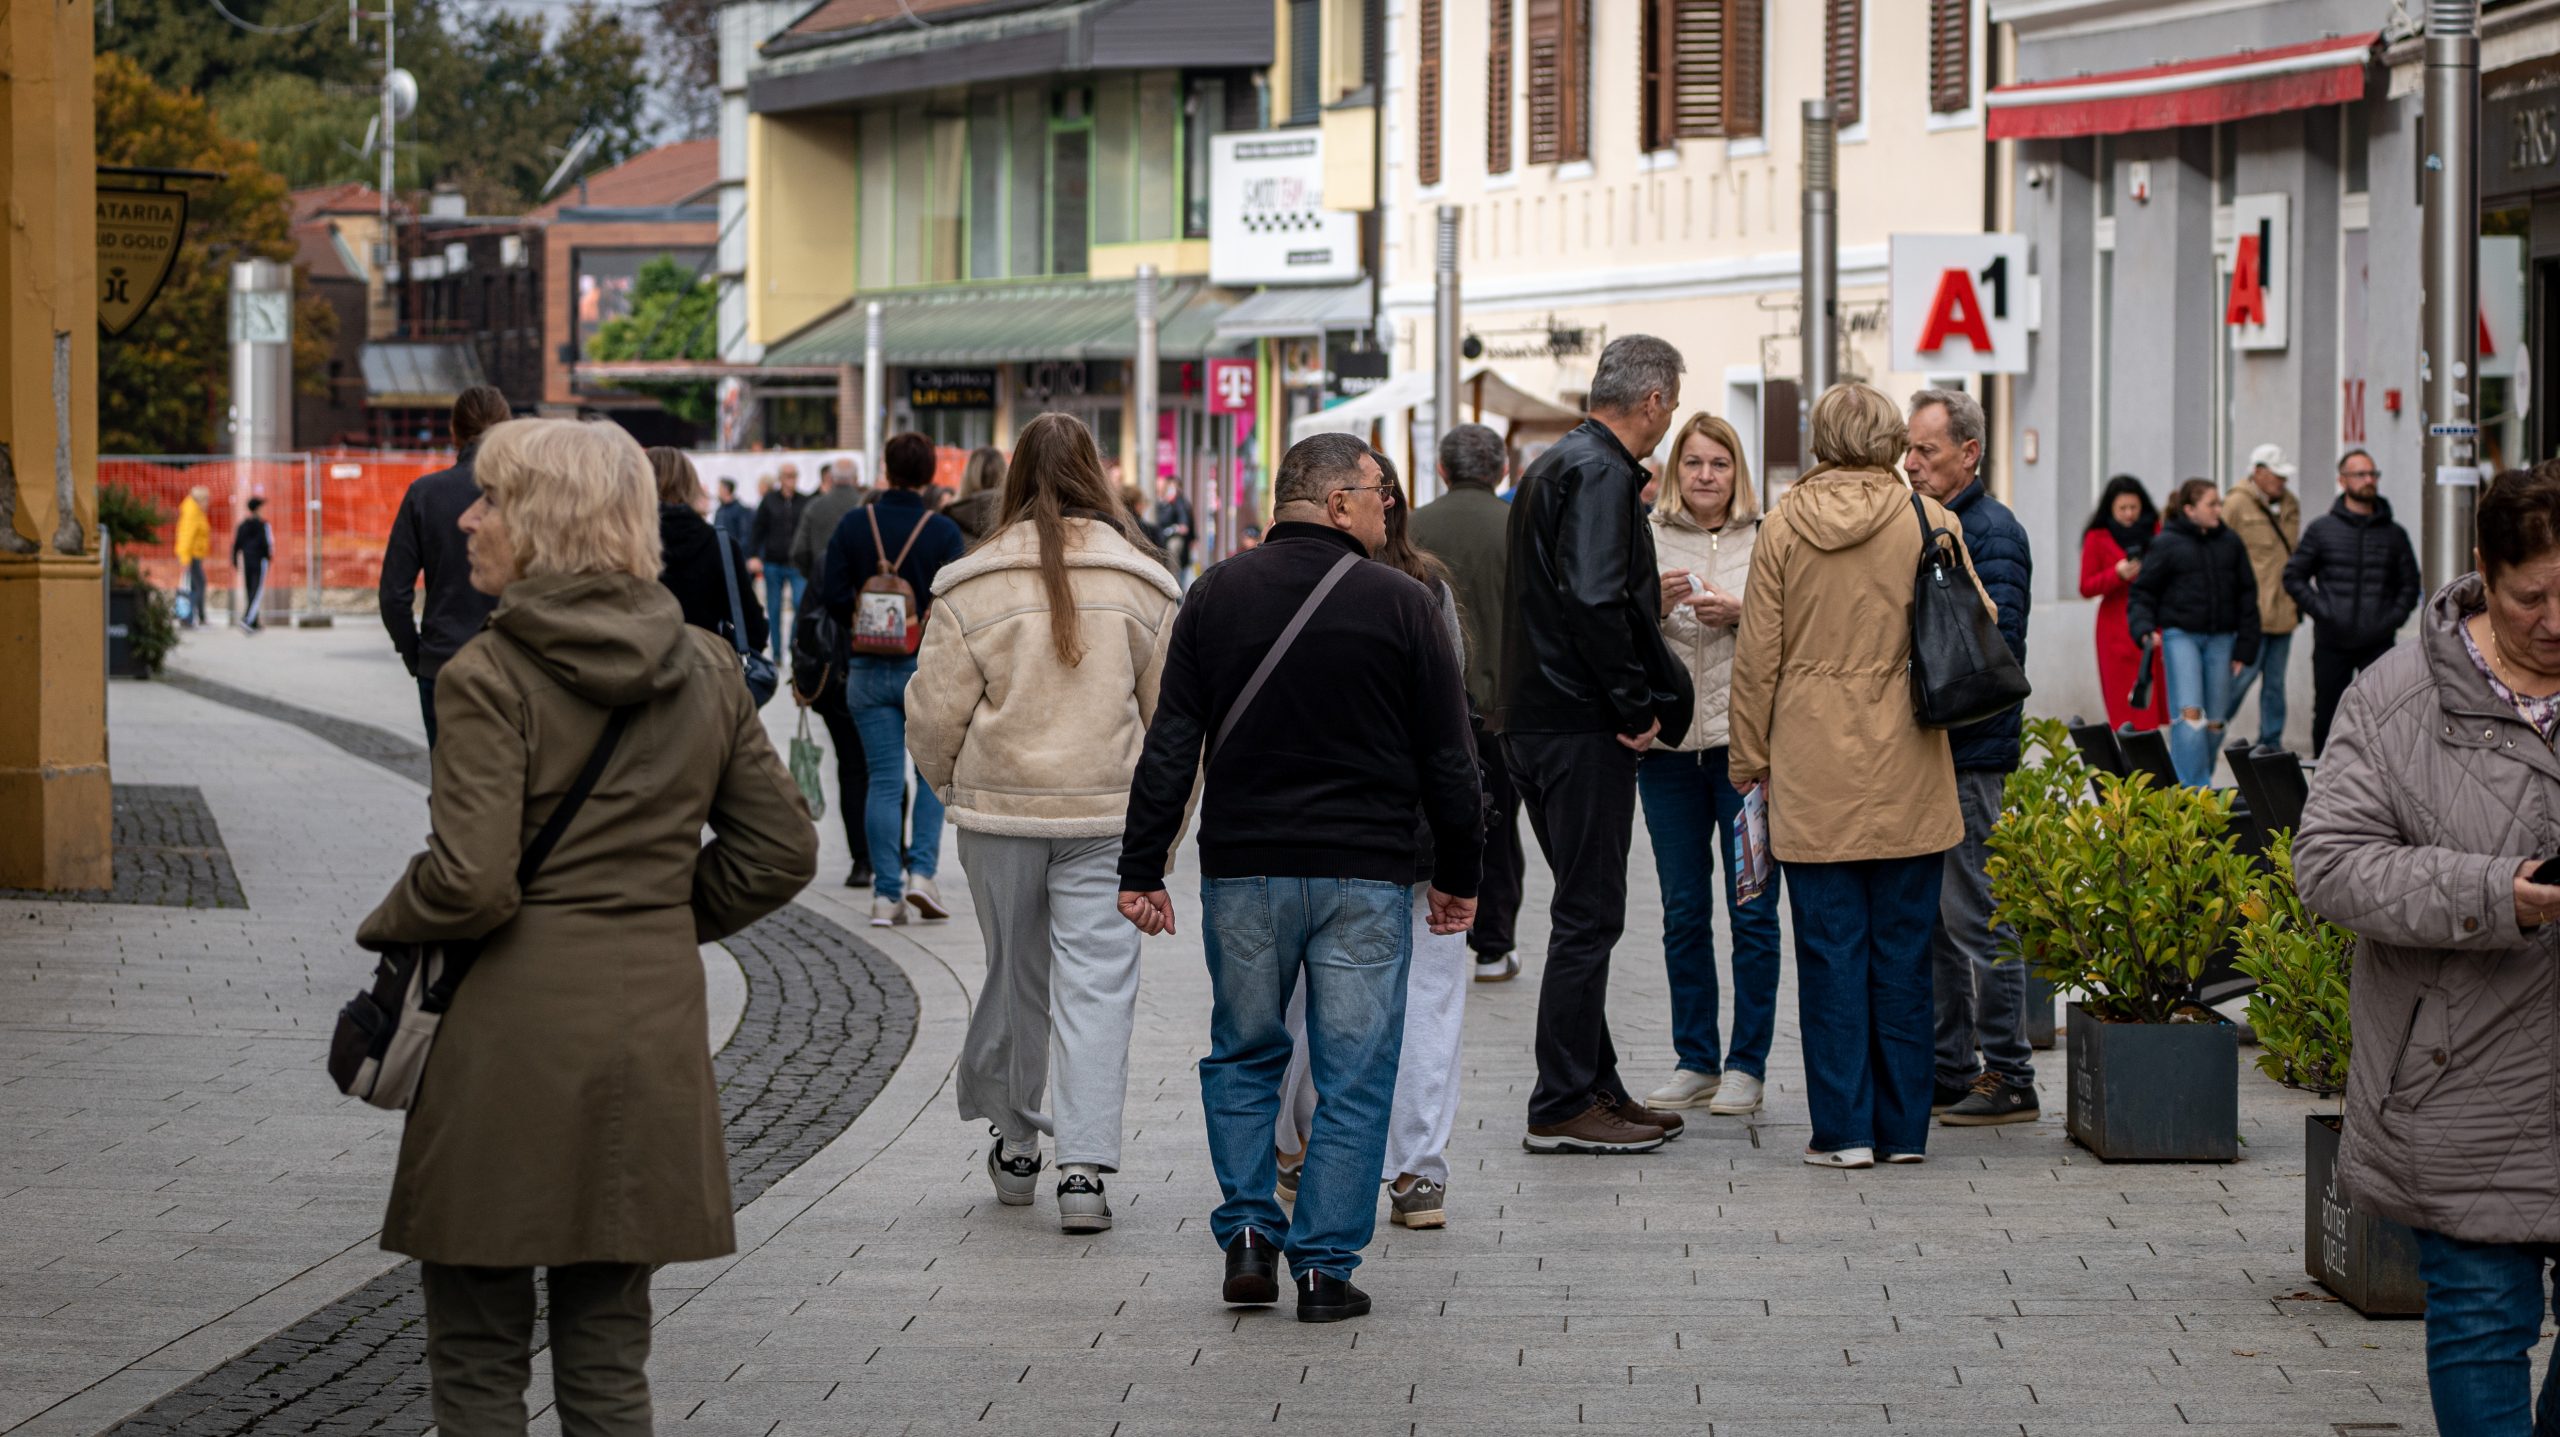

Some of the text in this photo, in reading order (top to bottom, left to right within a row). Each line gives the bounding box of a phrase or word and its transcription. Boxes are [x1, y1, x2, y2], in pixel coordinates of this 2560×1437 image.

[122, 233, 169, 249] GOLD
[1916, 254, 2007, 353] A1
[1218, 366, 1253, 408] T
[2323, 1234, 2346, 1278] QUELLE
